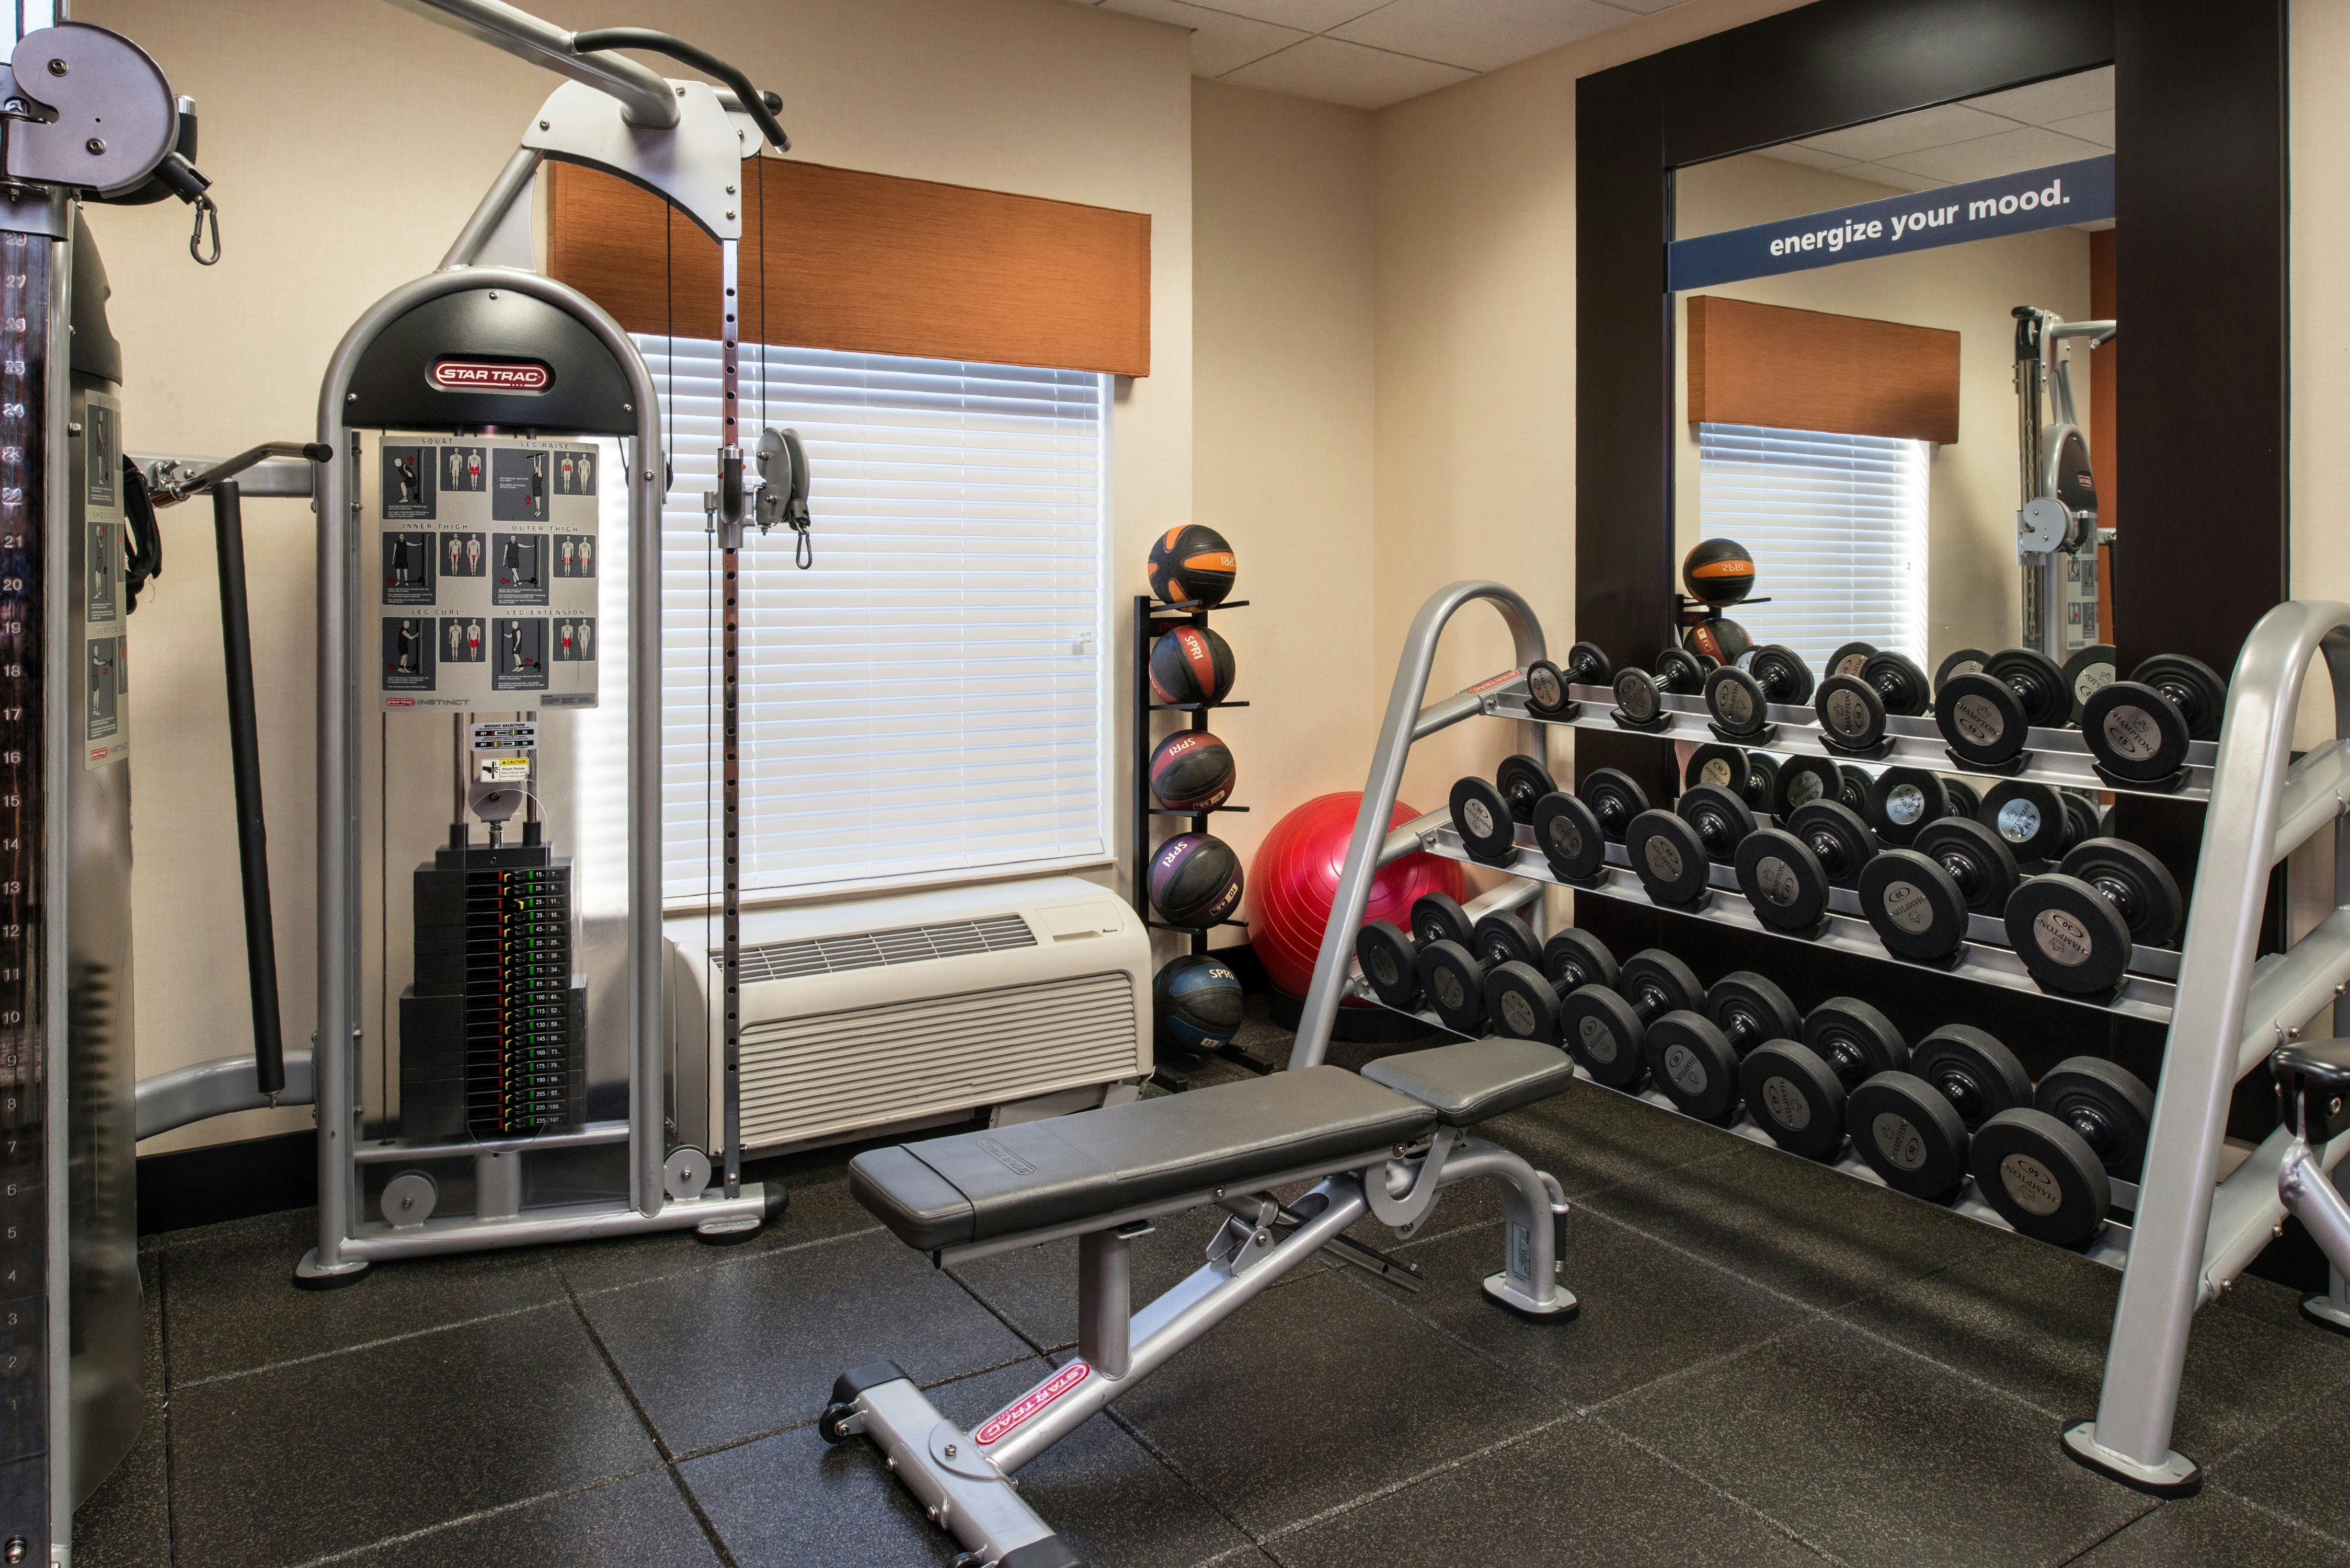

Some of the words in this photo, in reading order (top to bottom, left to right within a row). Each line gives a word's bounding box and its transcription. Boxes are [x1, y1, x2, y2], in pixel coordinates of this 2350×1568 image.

[1770, 219, 1883, 256] energize
[1890, 203, 1959, 241] your
[1969, 179, 2071, 221] mood.
[6, 275, 26, 288] 27
[6, 318, 26, 331] 26
[5, 361, 25, 375] 25
[444, 370, 488, 379] STAR
[491, 371, 538, 382] TRAC
[4, 403, 24, 418] 24
[3, 447, 24, 462] 23
[2, 488, 23, 505] 22
[4, 536, 23, 548] 21
[4, 578, 22, 591] 20
[4, 621, 21, 634] 19
[1185, 636, 1203, 660] SPRI
[4, 664, 21, 677] 18
[1498, 672, 1516, 682] STAR
[1474, 678, 1497, 691] TRAC
[1538, 670, 1553, 702] HAMPTON
[1728, 684, 1739, 717] HAMPTON
[4, 708, 21, 721] 17
[1856, 711, 1861, 719] 10
[1959, 704, 1998, 735] HAMPTON
[2113, 713, 2152, 752] HAMPTON
[1168, 737, 1196, 756] SPRI
[2118, 735, 2128, 746] 15
[3, 751, 20, 763] 16
[3, 796, 20, 807] 15
[1466, 808, 1492, 830] HAMPTON
[3, 839, 19, 850] 14
[1162, 841, 1188, 868] SPRI
[1651, 841, 1676, 875] HAMPTON
[1771, 865, 1785, 896] HAMPTON
[3, 882, 20, 894] 13
[1230, 887, 1236, 897] 10
[1785, 884, 1791, 893] 25
[1892, 895, 1926, 916] HAMPTON
[3, 925, 19, 937] 12
[2062, 920, 2073, 930] 30
[2039, 920, 2087, 956] HAMPTON
[4, 969, 19, 979] 11
[1209, 969, 1234, 980] SPRI
[3, 1011, 19, 1022] 10
[1589, 1028, 1608, 1049] HAMPTON
[7, 1055, 16, 1067] 9
[1674, 1055, 1680, 1064] 45
[1678, 1056, 1697, 1083] HAMPTON
[7, 1099, 16, 1111] 8
[1772, 1096, 1777, 1104] 45
[1779, 1081, 1794, 1125] HAMPTON
[8, 1142, 16, 1152] 7
[1892, 1123, 1908, 1159] HAMPTON
[1908, 1146, 1916, 1155] 50
[2028, 1167, 2039, 1176] 50
[7, 1184, 16, 1196] 6
[2005, 1165, 2056, 1204] HAMPTON
[8, 1227, 16, 1239] 5
[8, 1270, 17, 1282] 4
[8, 1313, 17, 1324] 3
[8, 1356, 17, 1367] 2
[1036, 1370, 1079, 1402] STAR
[12, 1400, 16, 1410] 1
[987, 1402, 1037, 1436] TRAC
